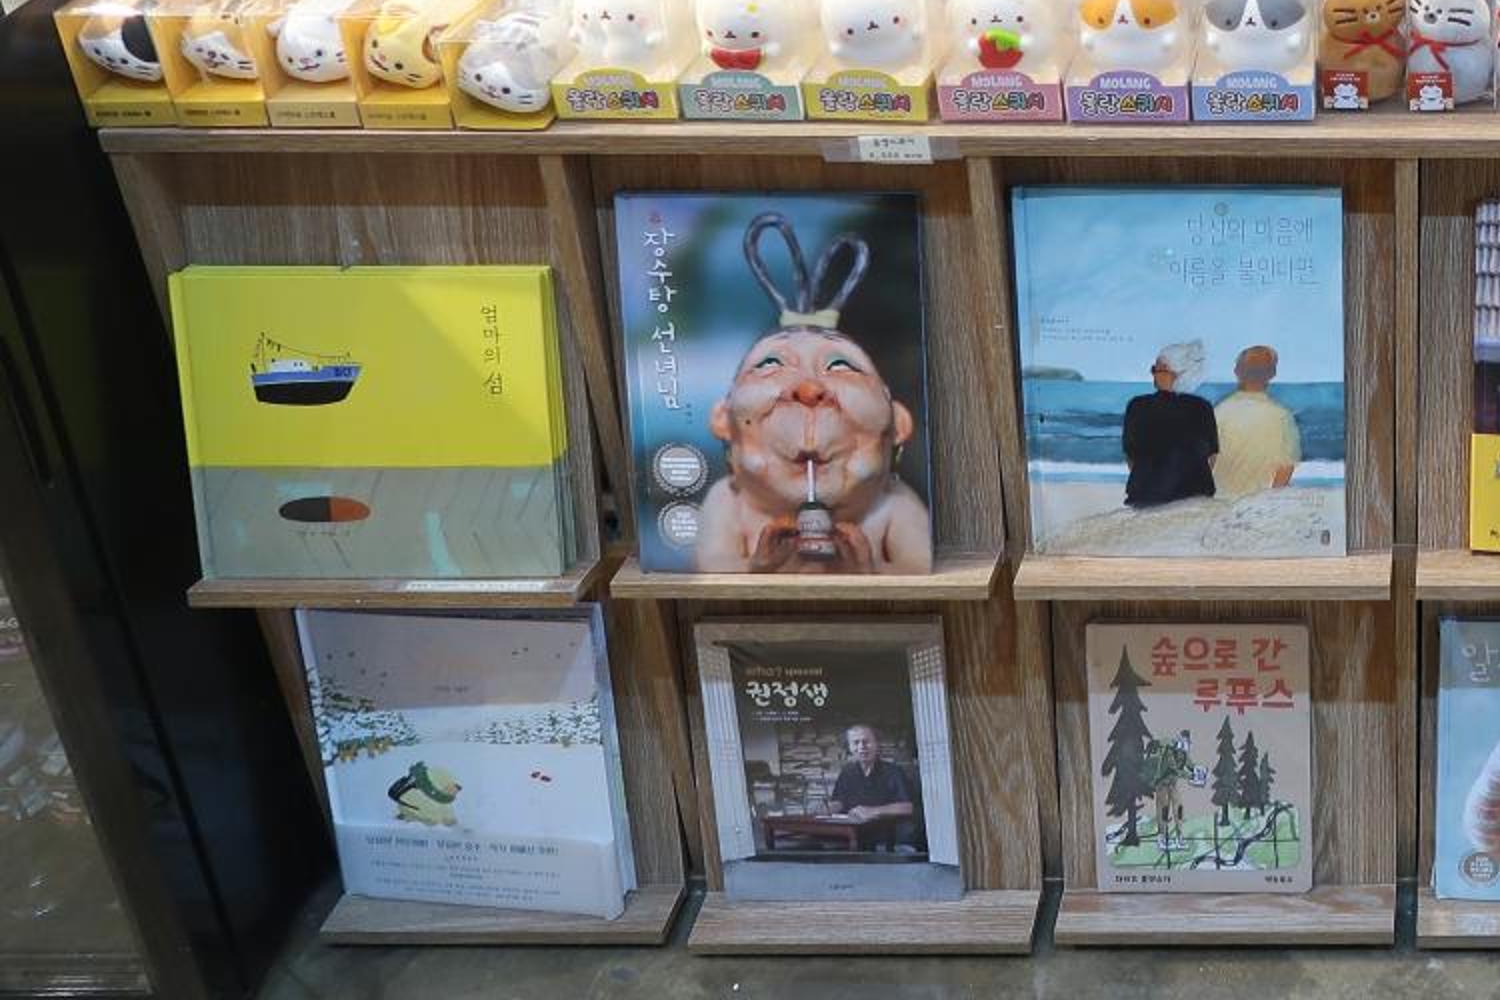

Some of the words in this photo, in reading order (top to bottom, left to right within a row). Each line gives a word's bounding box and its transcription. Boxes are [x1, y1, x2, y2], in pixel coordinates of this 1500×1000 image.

[1099, 77, 1152, 90] MOLANG
[1226, 77, 1278, 90] MOLANG
[1185, 212, 1246, 247] 당신의
[1254, 215, 1314, 248] 마음에
[642, 226, 678, 313] 장수탕
[1168, 252, 1227, 287] 이름을
[477, 303, 501, 363] 엄마의
[651, 322, 681, 409] 선녀님
[481, 371, 504, 398] 섬
[1150, 635, 1240, 678] 숲으로
[1251, 637, 1291, 673] 간
[745, 681, 829, 708] 권정생
[1192, 676, 1295, 714] 루푸스
